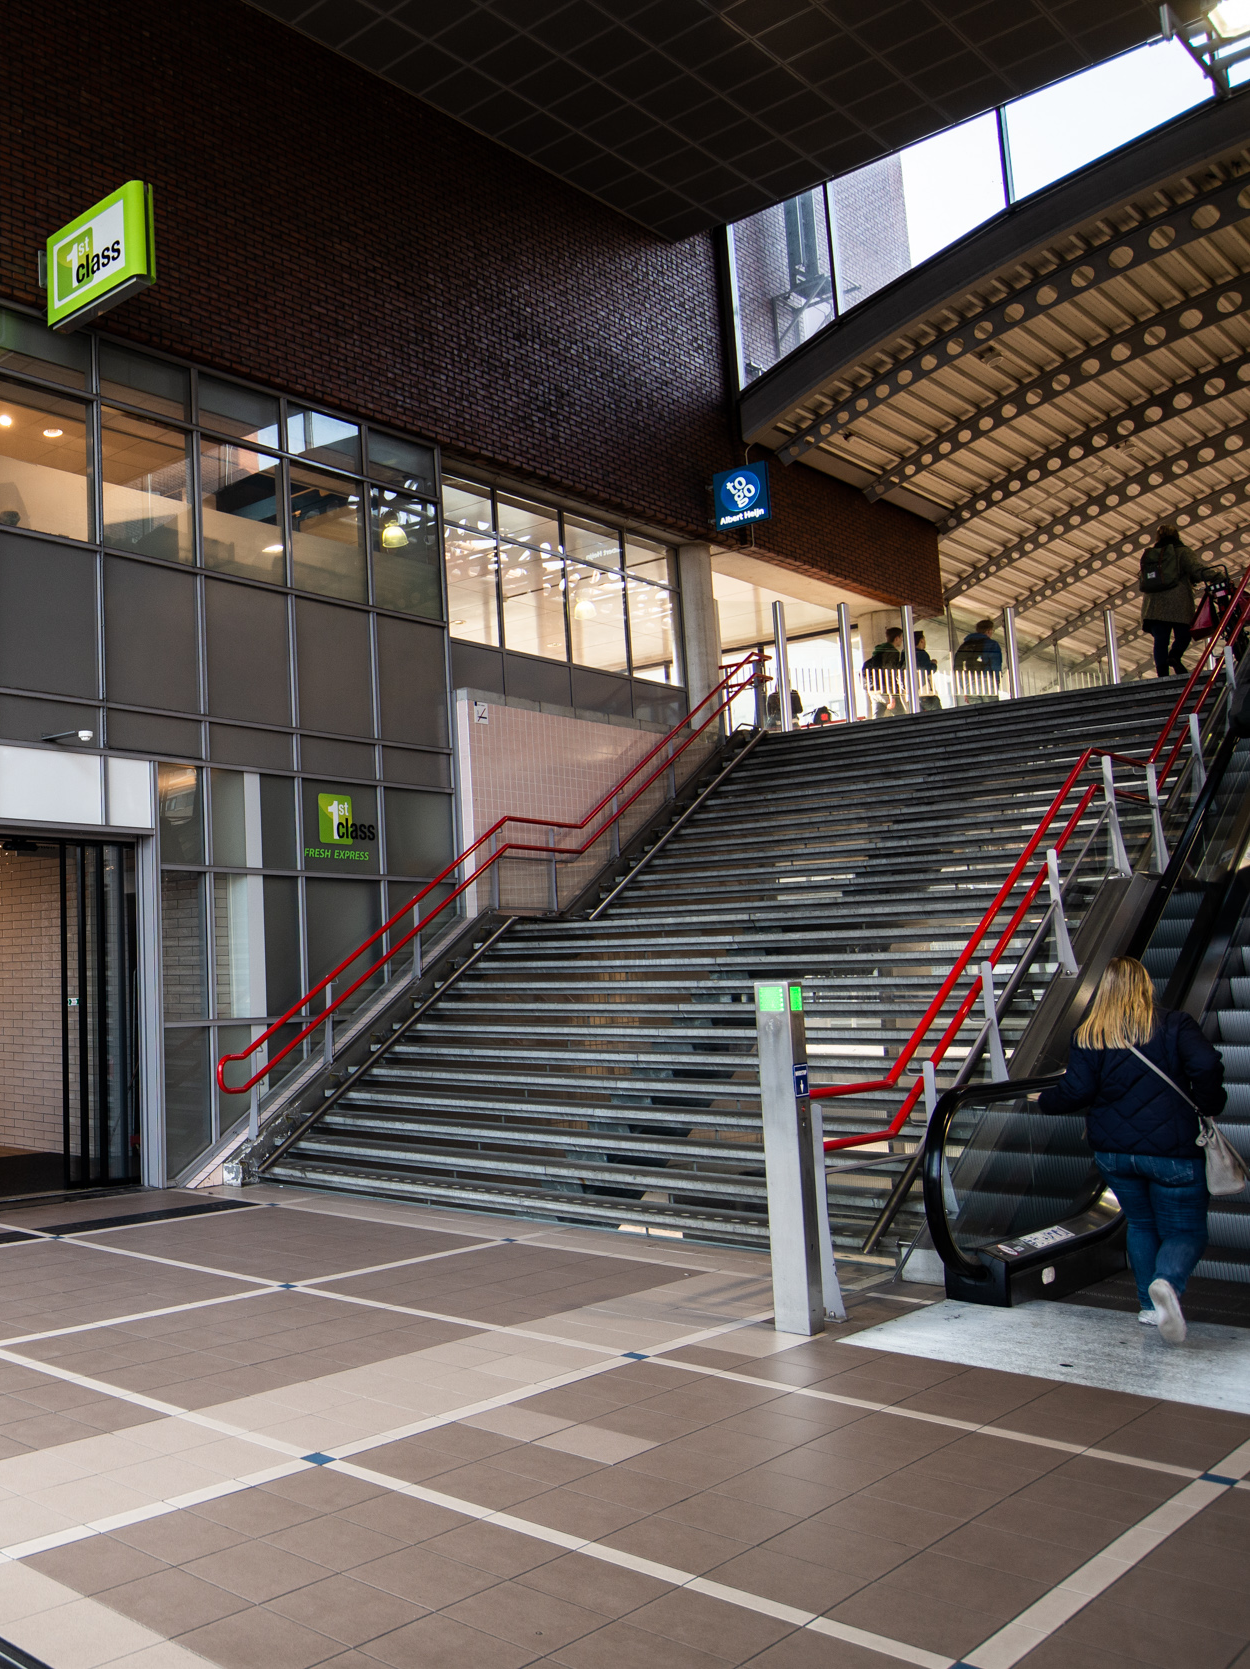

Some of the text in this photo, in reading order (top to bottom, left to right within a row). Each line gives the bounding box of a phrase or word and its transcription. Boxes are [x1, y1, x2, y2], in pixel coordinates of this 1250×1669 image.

[66, 236, 90, 289] 1st
[76, 240, 121, 283] class
[726, 477, 747, 495] to
[734, 484, 756, 508] go
[720, 508, 765, 526] Albert Heijn
[327, 800, 349, 840] 1st
[336, 817, 376, 841] class
[304, 847, 370, 861] FRESH EXPRESS
